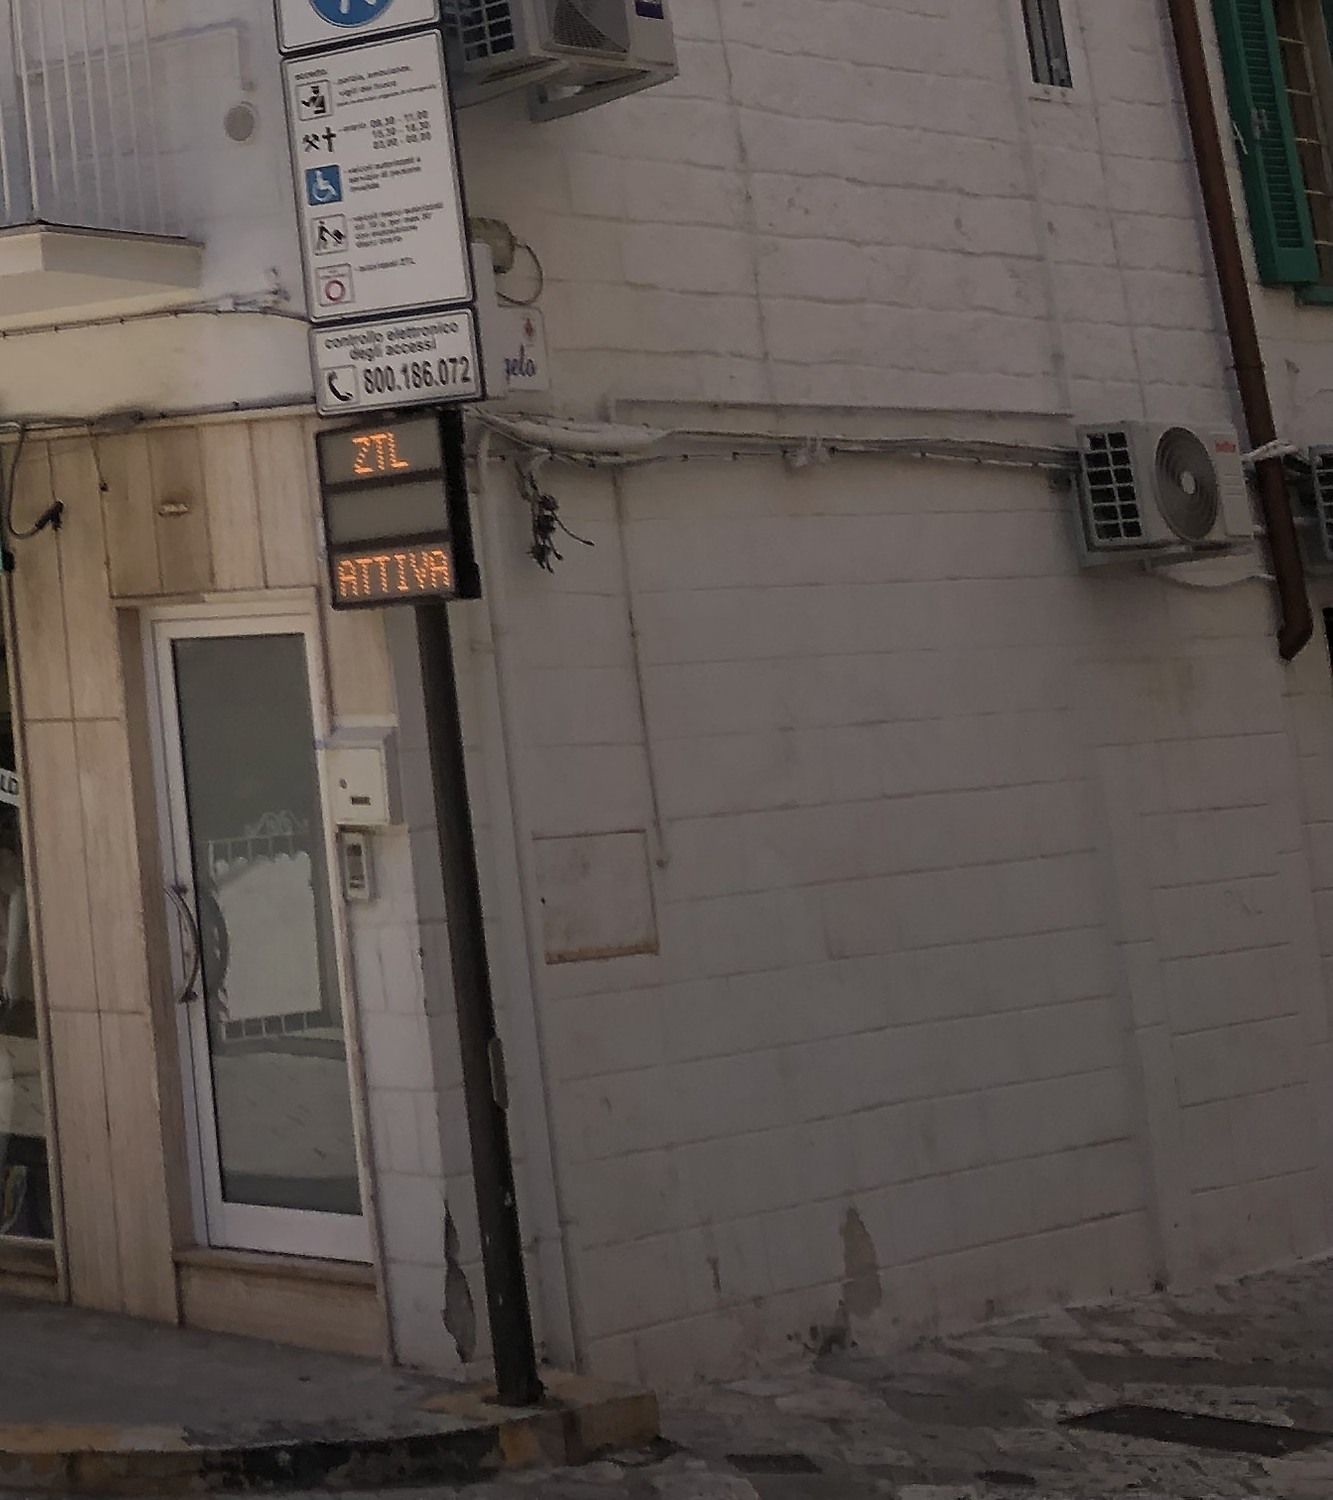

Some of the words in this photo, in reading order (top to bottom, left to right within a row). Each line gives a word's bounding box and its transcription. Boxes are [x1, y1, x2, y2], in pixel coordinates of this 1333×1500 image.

[363, 356, 471, 394] 800.186.072
[352, 431, 409, 474] ZTL
[338, 548, 450, 597] ATTIVA
